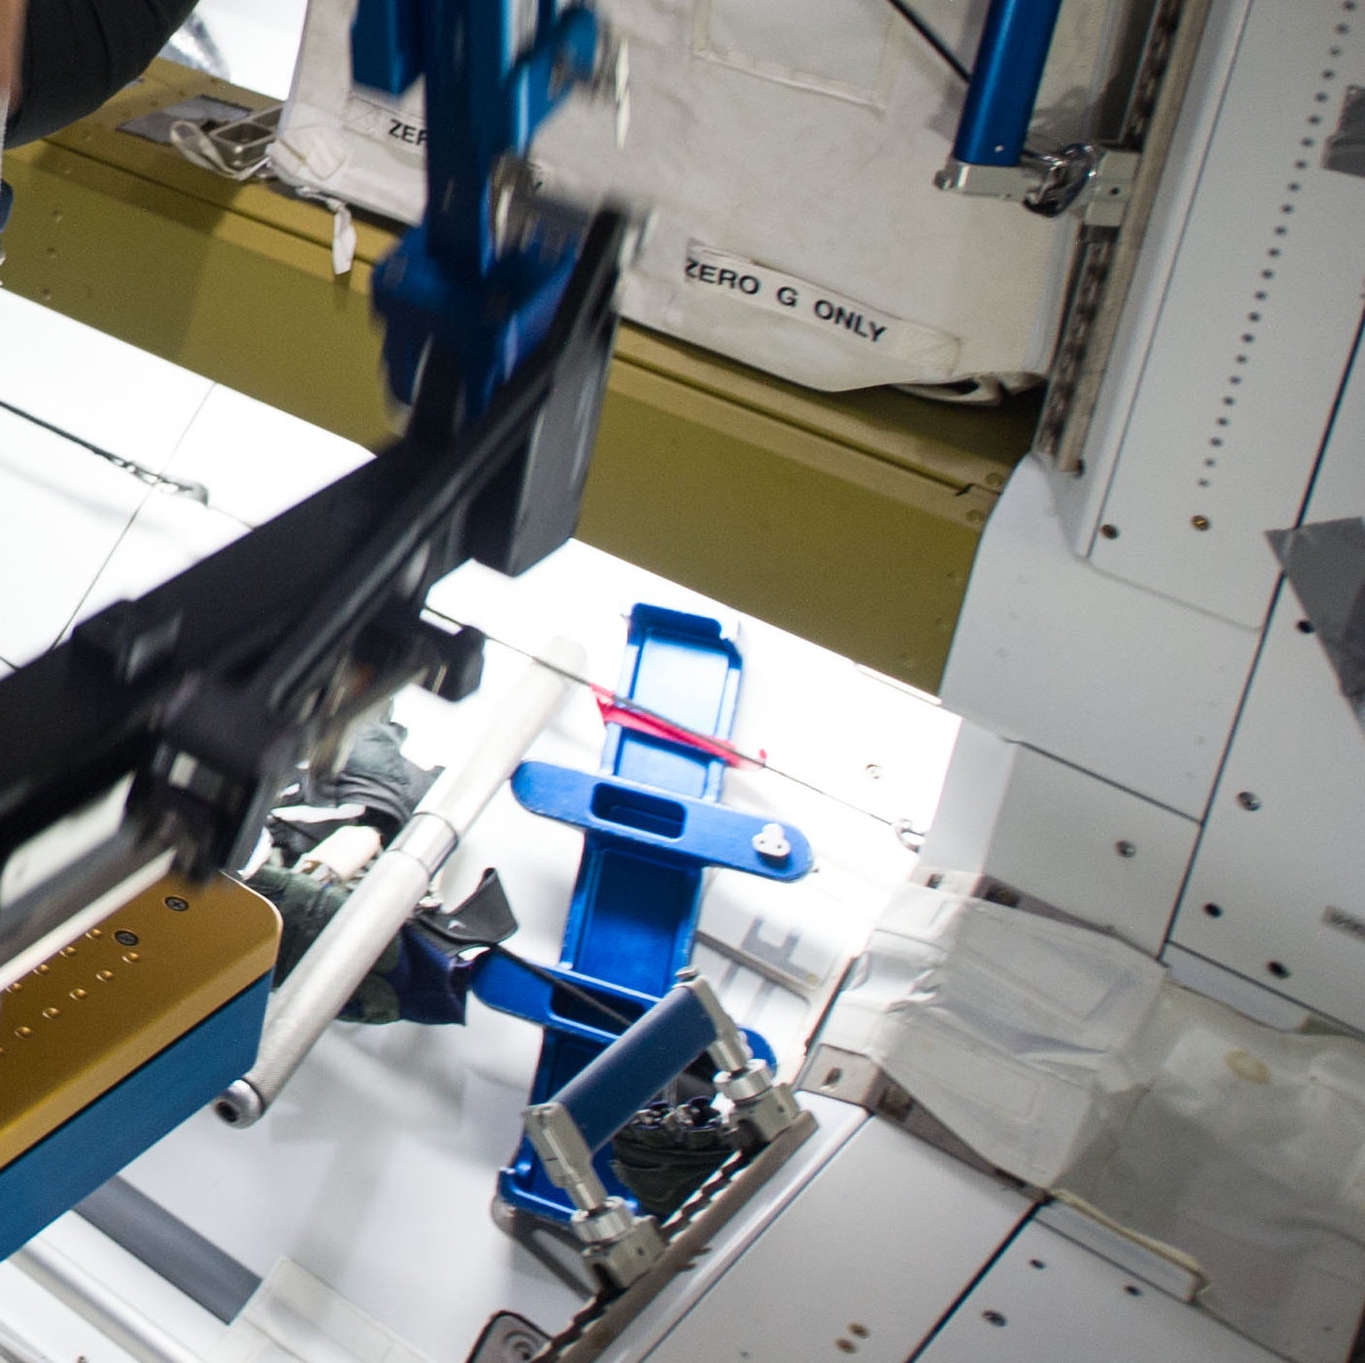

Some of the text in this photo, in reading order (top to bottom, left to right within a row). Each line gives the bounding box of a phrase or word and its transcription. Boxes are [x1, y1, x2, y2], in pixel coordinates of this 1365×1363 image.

[685, 257, 887, 342] ZERO G ONLY
